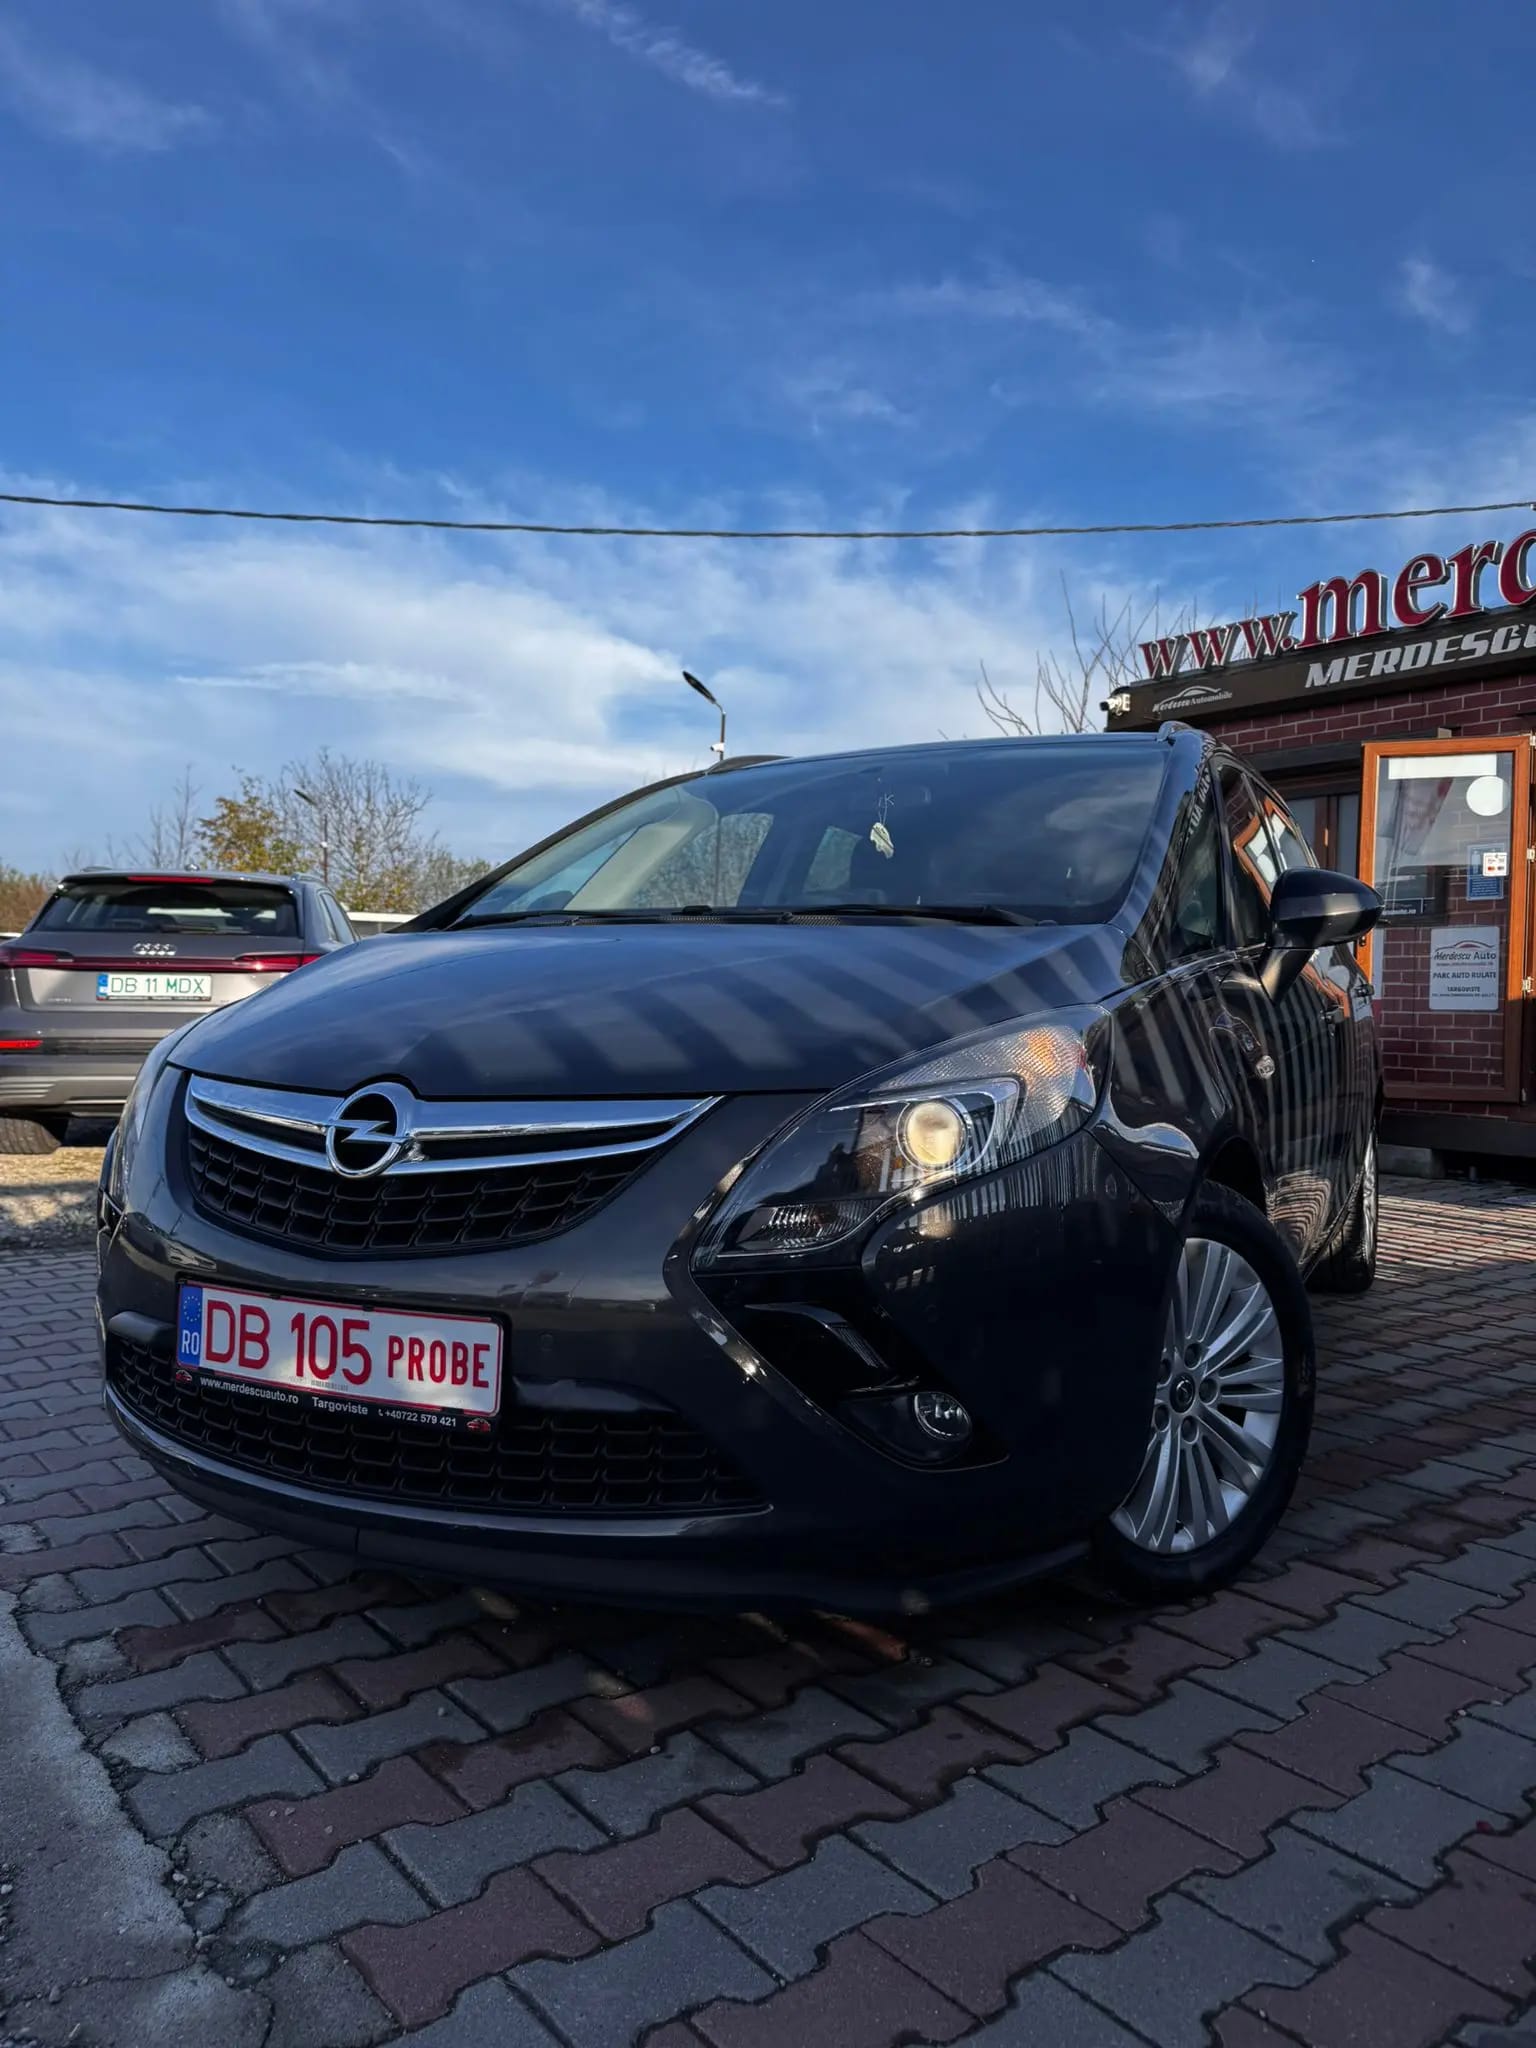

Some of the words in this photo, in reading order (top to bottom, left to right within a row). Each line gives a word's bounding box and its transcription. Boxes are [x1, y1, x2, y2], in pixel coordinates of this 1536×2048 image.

[1473, 951, 1497, 960] Auto
[111, 977, 138, 993] DB
[145, 977, 158, 993] 11
[166, 978, 205, 994] MDX
[181, 1329, 200, 1356] RO
[204, 1299, 270, 1370] DB
[290, 1312, 372, 1386] 105
[387, 1335, 490, 1388] PROBE
[199, 1376, 299, 1405] www.merdescuauto.ro
[311, 1396, 369, 1416] Targoviste
[384, 1409, 418, 1423] +40722
[420, 1413, 438, 1425] 579
[439, 1416, 457, 1428] 421
